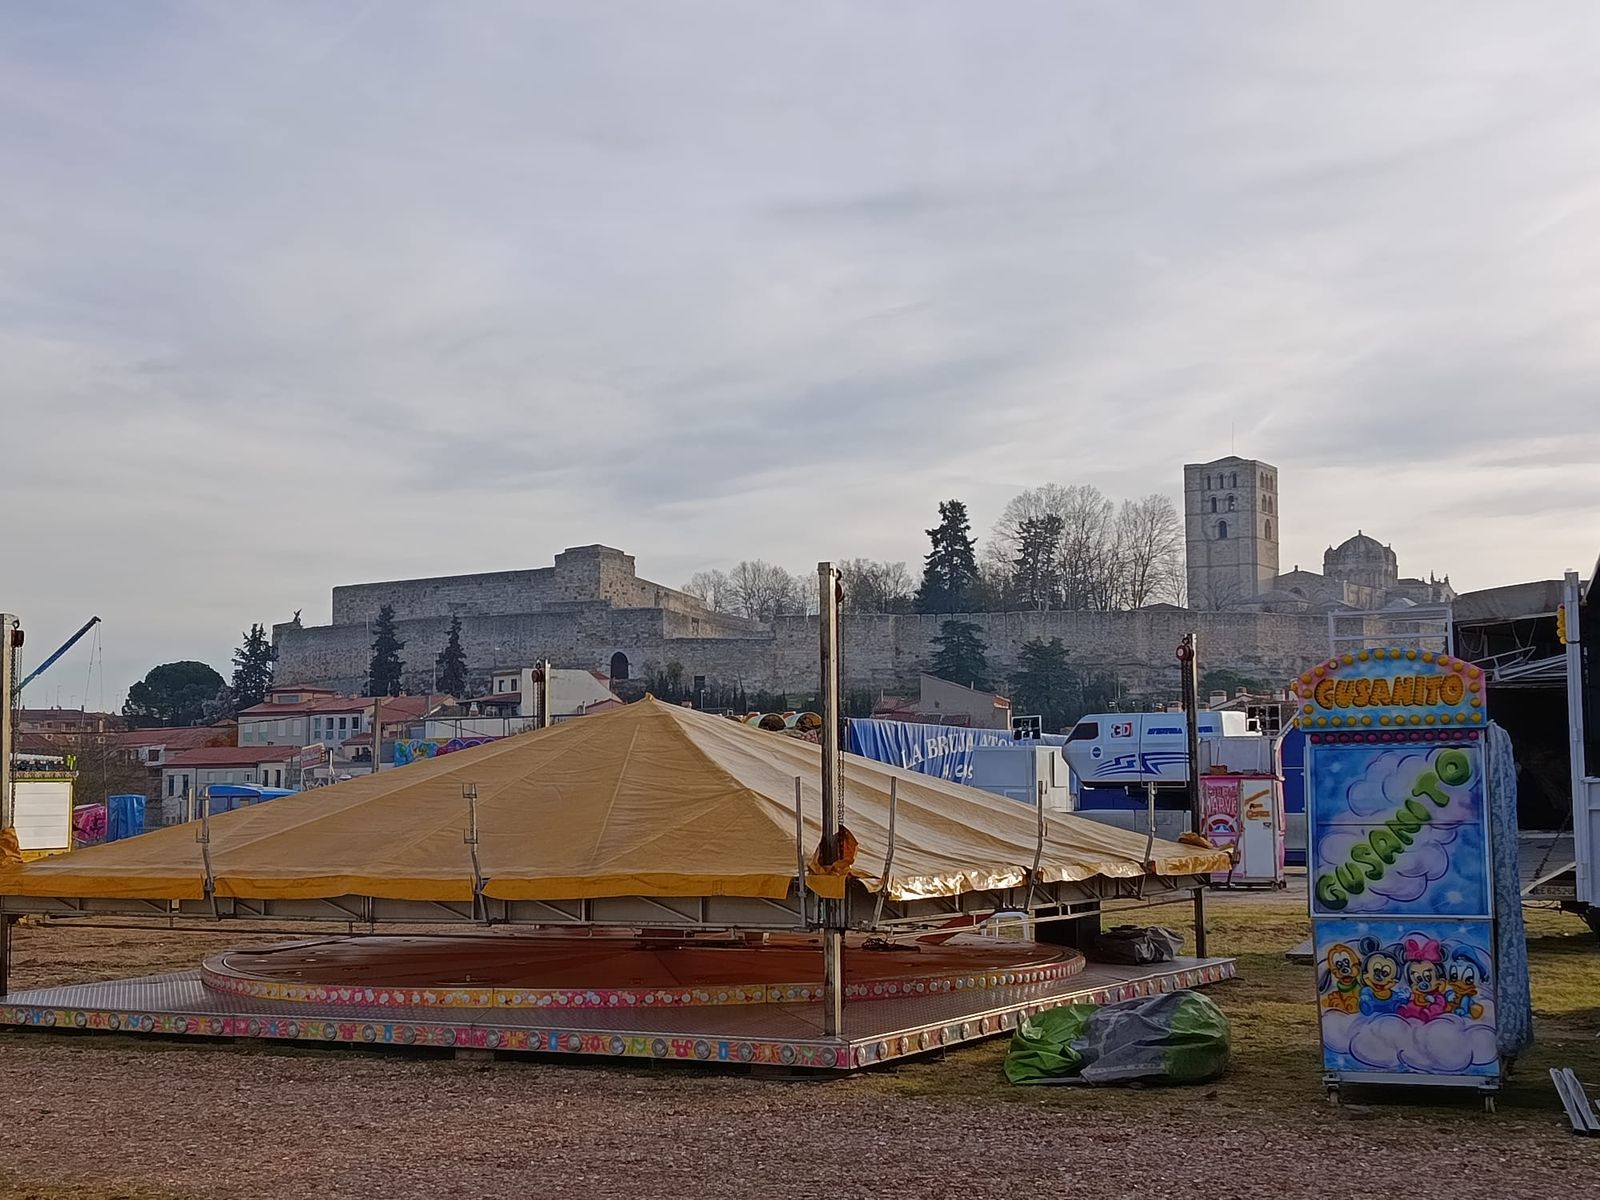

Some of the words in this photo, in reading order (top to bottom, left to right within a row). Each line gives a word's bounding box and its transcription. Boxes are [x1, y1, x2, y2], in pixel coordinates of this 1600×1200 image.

[1314, 674, 1464, 709] GUSANITO
[901, 744, 925, 769] LA
[926, 732, 974, 759] BRUJA
[1315, 749, 1470, 911] GUSANITO
